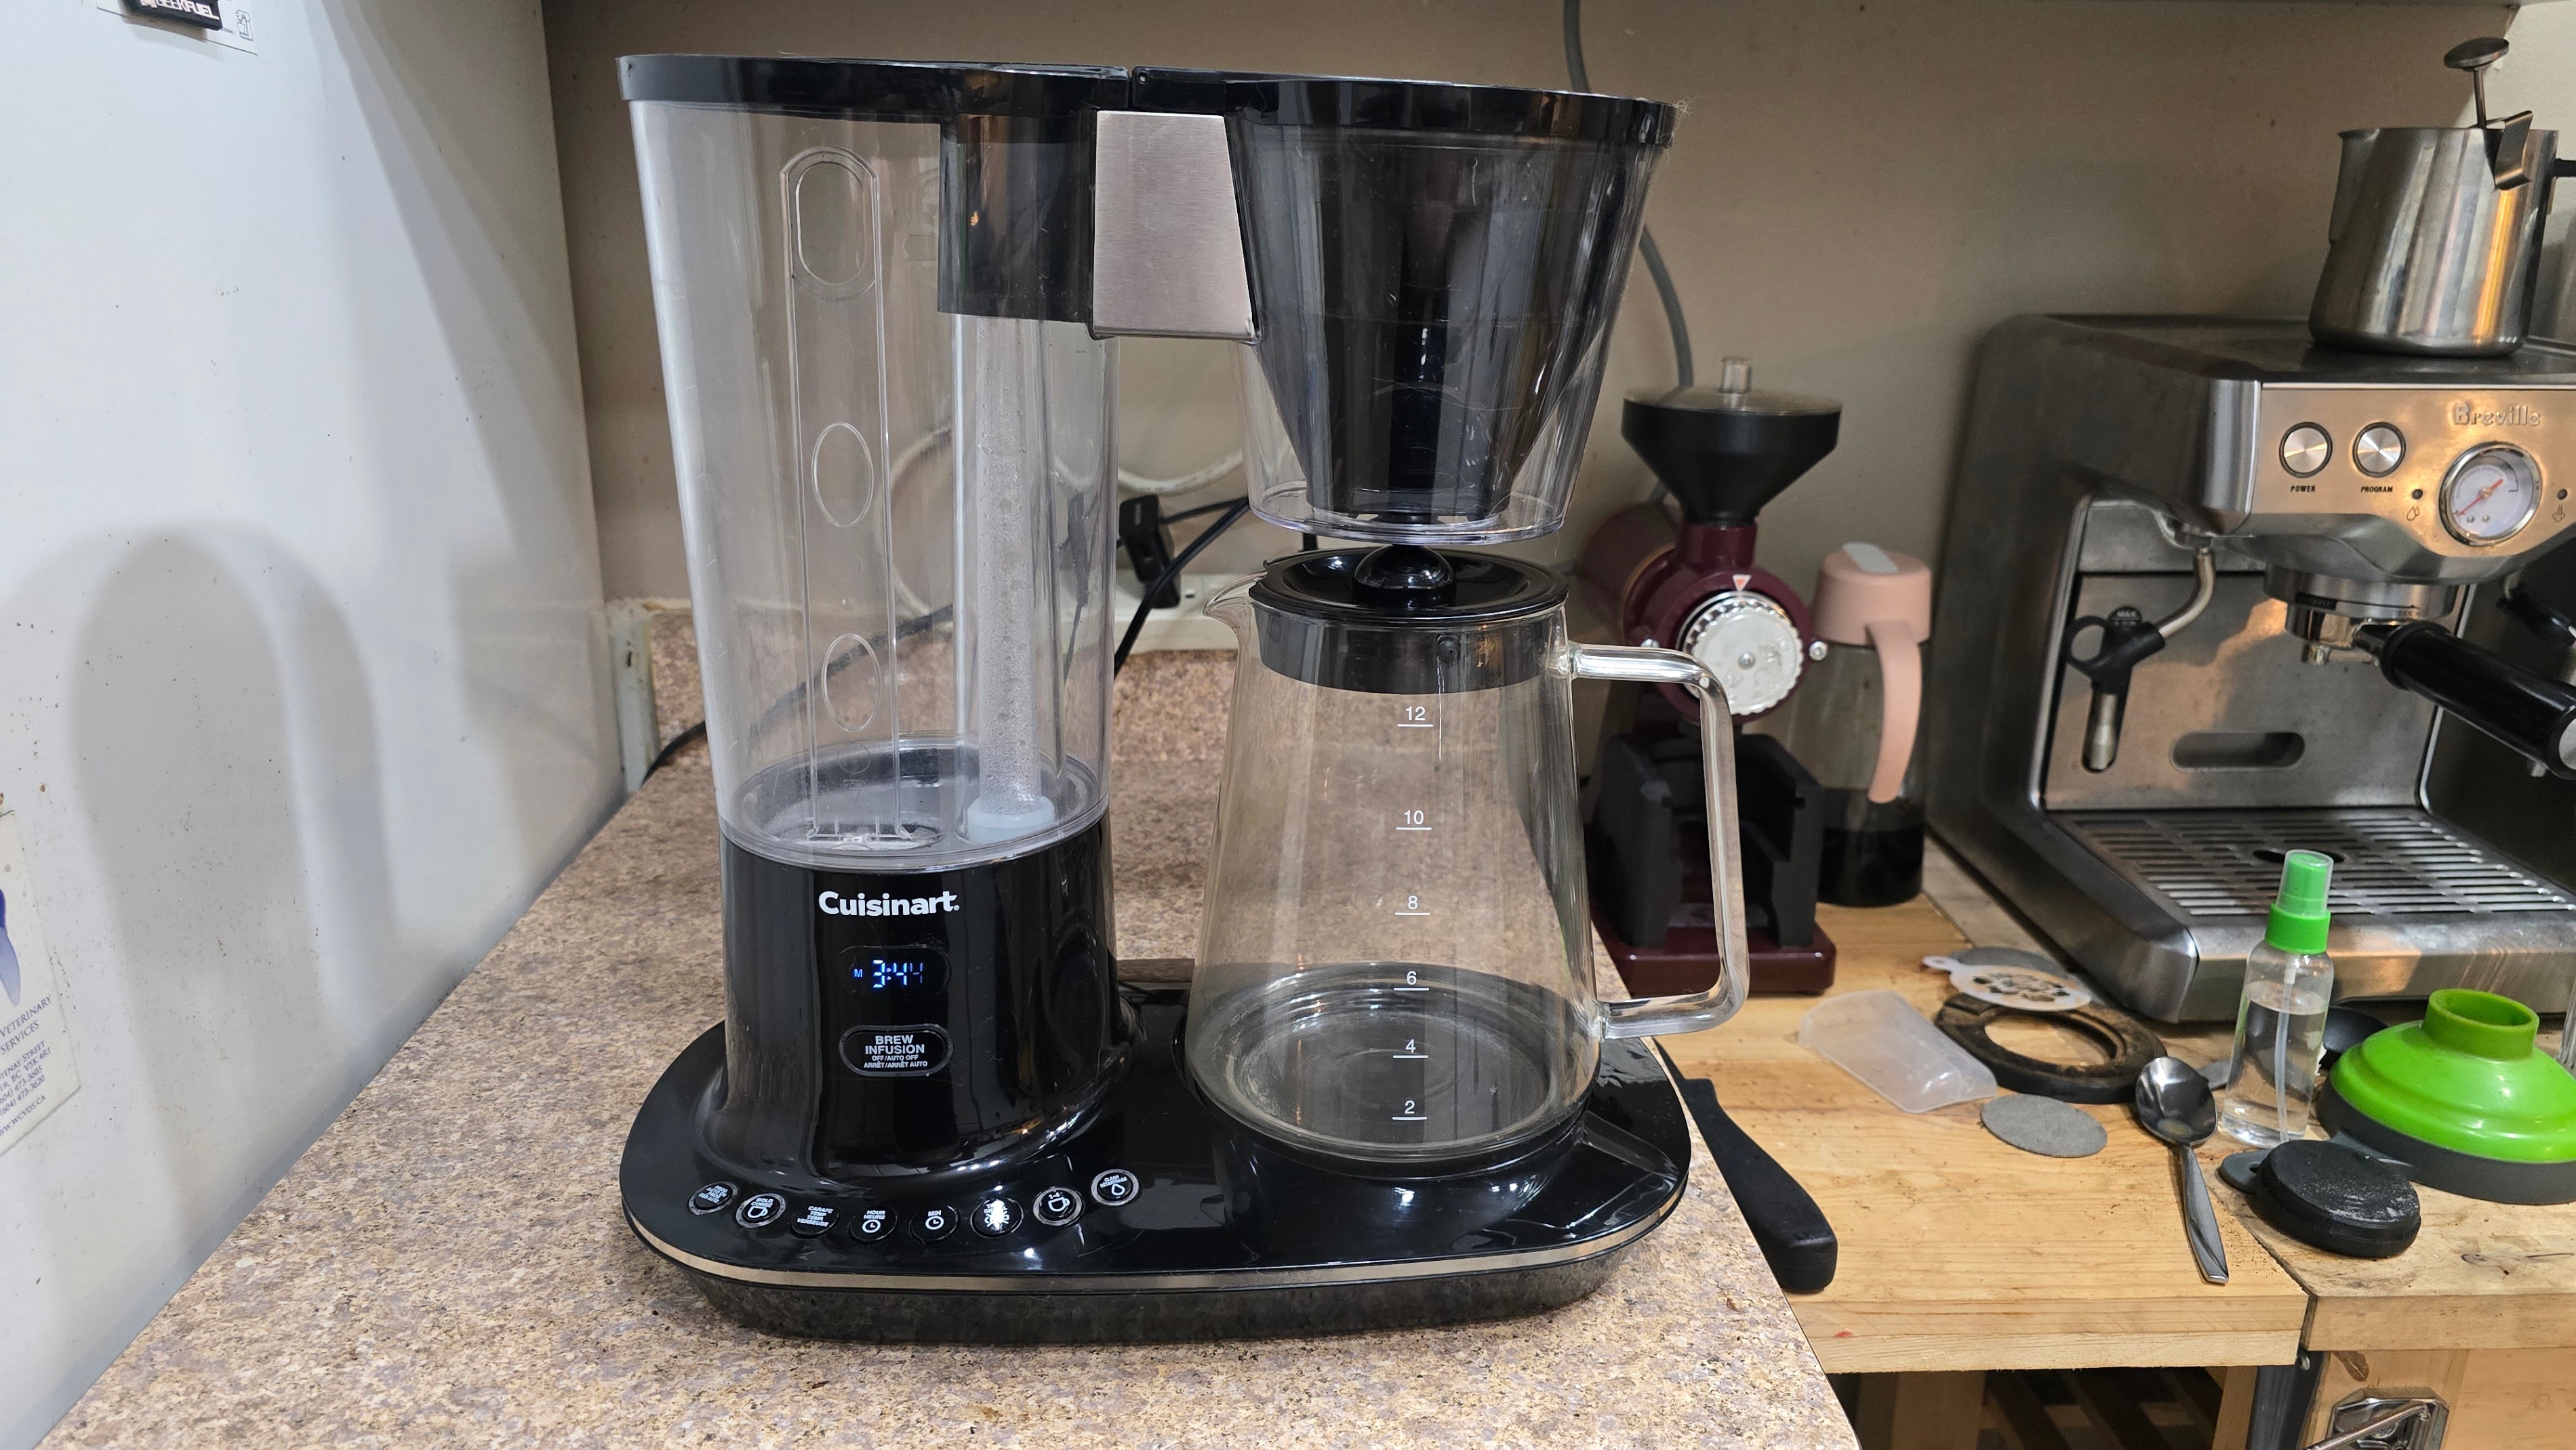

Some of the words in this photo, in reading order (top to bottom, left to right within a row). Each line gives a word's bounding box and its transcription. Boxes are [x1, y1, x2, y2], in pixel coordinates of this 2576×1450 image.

[2453, 403, 2541, 426] Breville
[1405, 707, 1426, 721] 12
[1404, 811, 1424, 824] 10
[1408, 896, 1418, 910] 8
[872, 959, 923, 988] 3:44
[1407, 971, 1417, 985] 6
[0, 994, 51, 1037] VETERINARY
[1, 1020, 39, 1055] SERVICES
[875, 1034, 914, 1045] BREW
[865, 1044, 925, 1055] INFUSION
[1405, 1040, 1416, 1053] 4
[0, 1058, 21, 1079] TENAY
[22, 1039, 45, 1062] STREET
[12, 1070, 22, 1083] BC
[0, 1087, 13, 1104] 604)
[1405, 1101, 1415, 1114] 2
[797, 1218, 829, 1227] VERSEUSE
